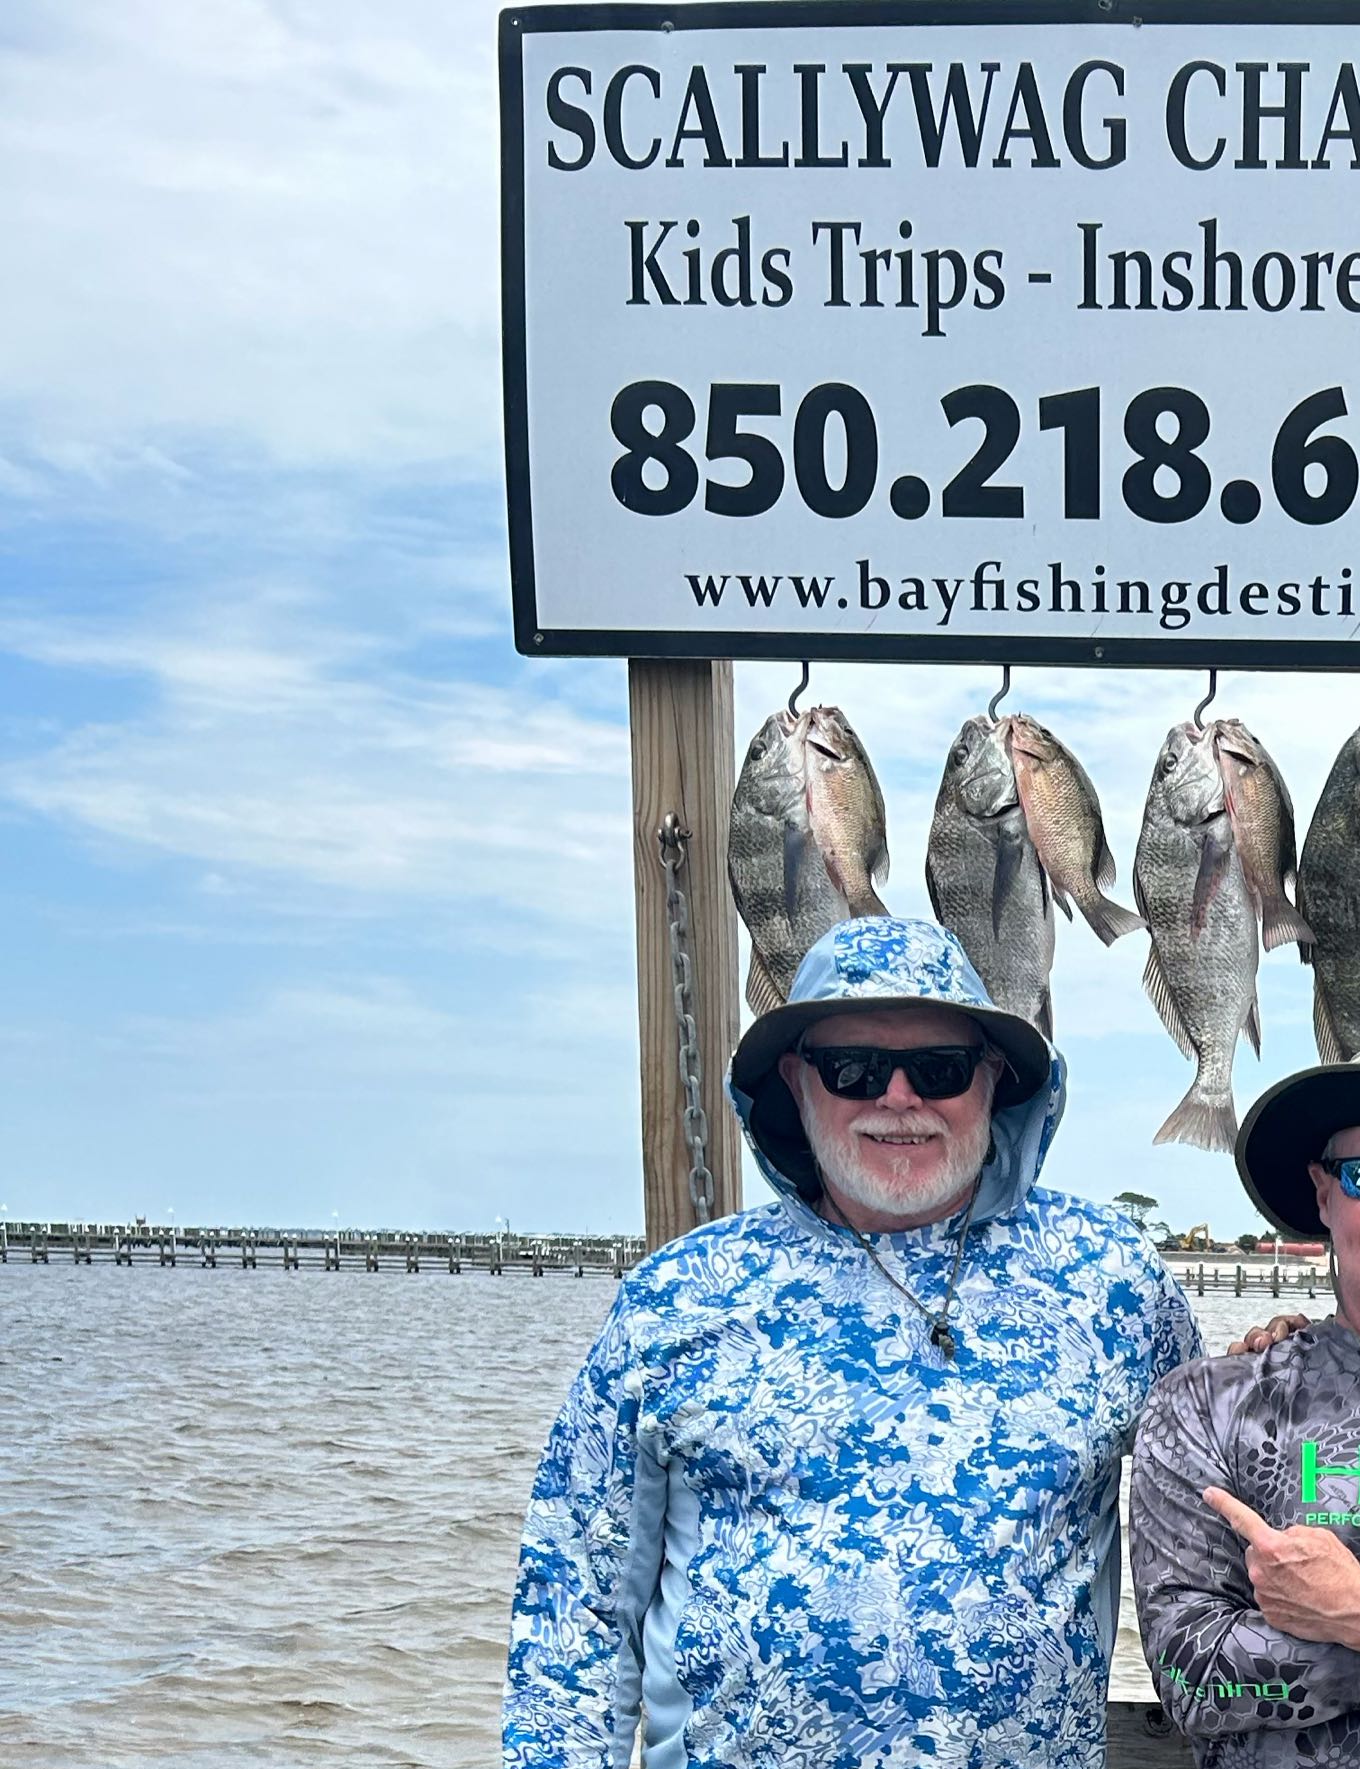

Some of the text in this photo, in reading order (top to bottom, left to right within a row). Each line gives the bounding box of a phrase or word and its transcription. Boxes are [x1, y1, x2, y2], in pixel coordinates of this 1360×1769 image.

[546, 60, 1127, 172] SCALLYWAG
[624, 215, 794, 308] Kids
[811, 220, 1005, 337] Trips
